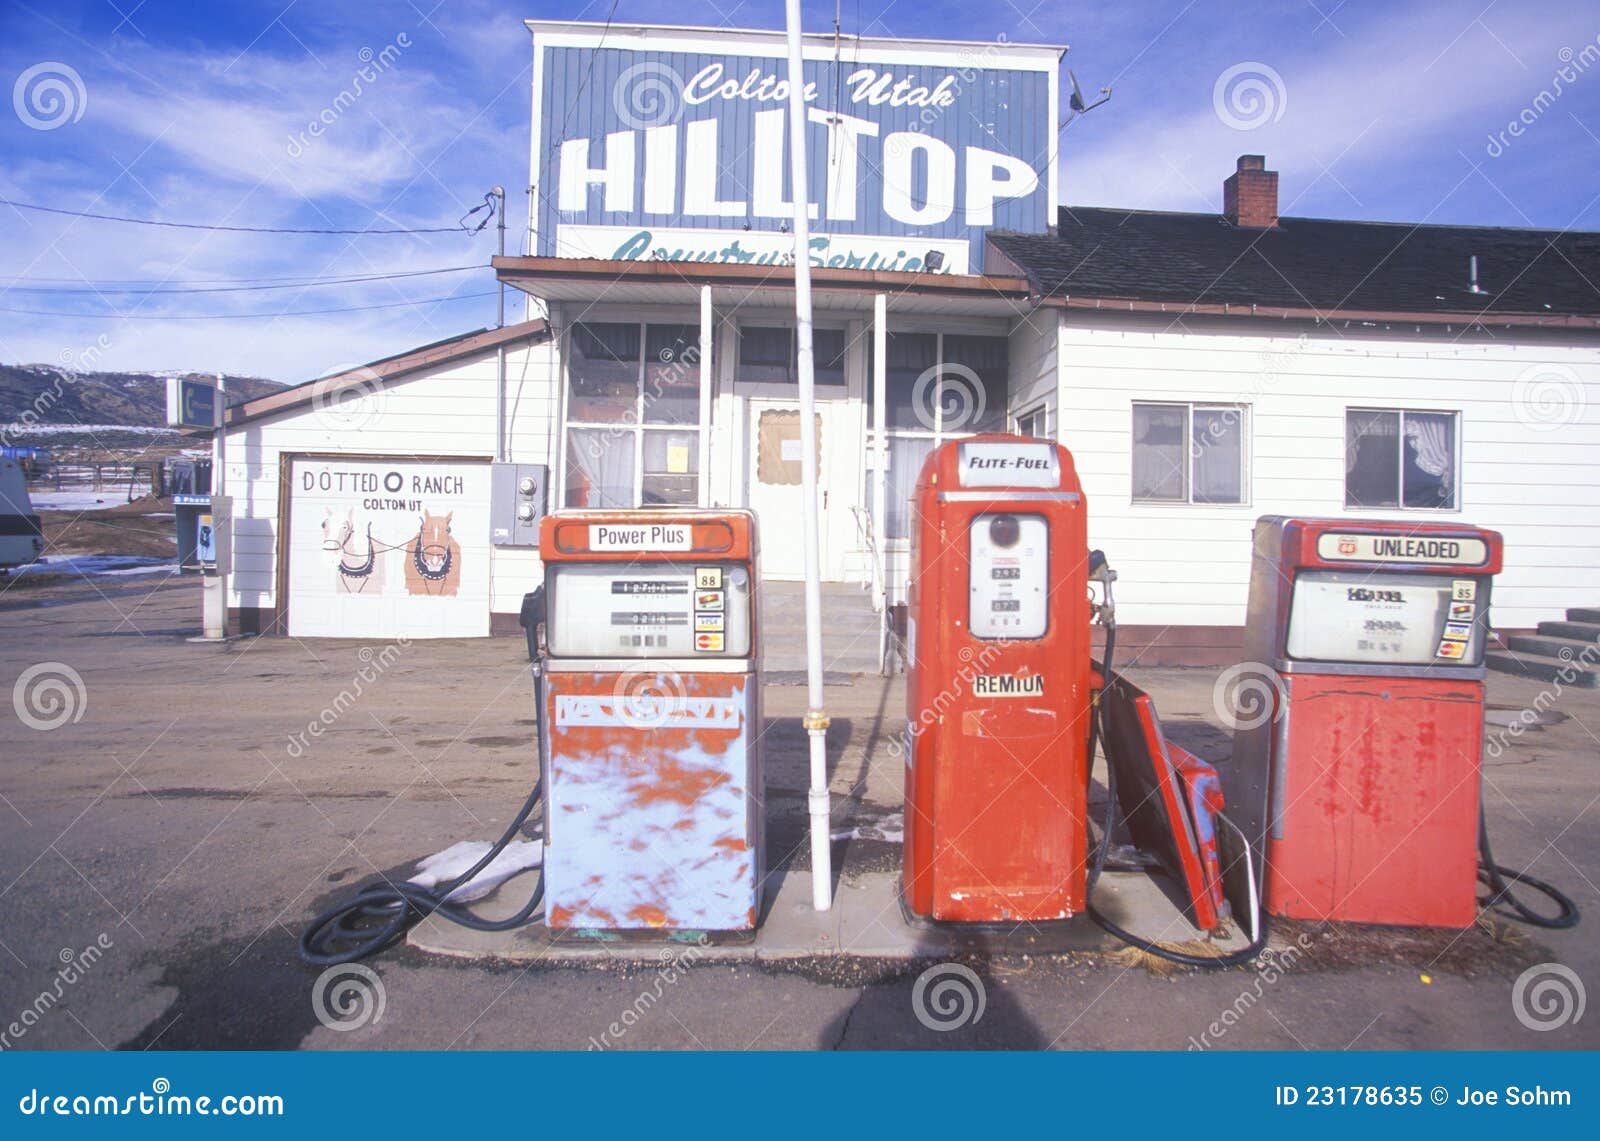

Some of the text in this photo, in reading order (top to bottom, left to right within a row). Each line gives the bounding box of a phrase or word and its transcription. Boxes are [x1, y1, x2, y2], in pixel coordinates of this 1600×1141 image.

[683, 63, 956, 107] Colton Utah
[558, 107, 1038, 226] HILLTOP
[969, 456, 1049, 470] FLITE-FUEL
[303, 471, 378, 492] DOTTED
[412, 475, 464, 495] RANCH
[363, 499, 422, 512] COLTON UT
[598, 526, 684, 544] Power Plus
[1373, 539, 1460, 558] UNLEADED
[702, 575, 716, 586] 88
[1457, 588, 1471, 599] 85
